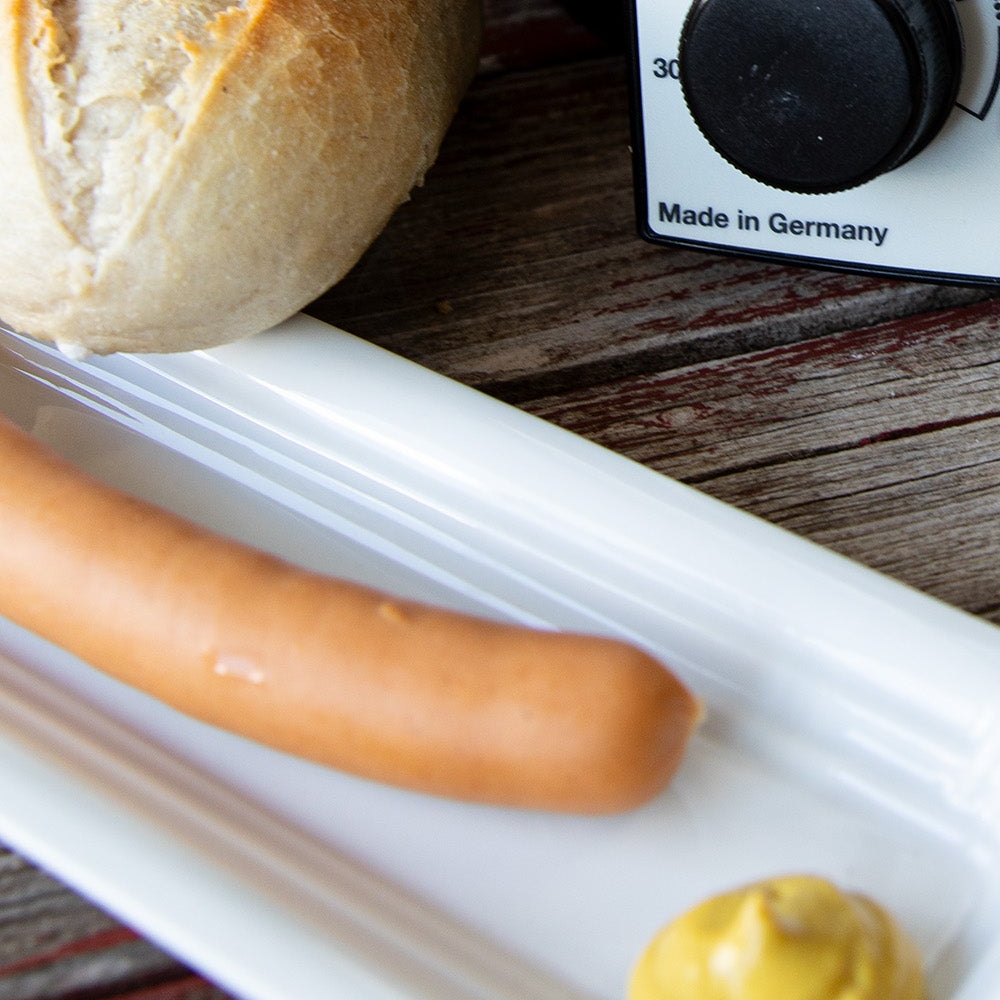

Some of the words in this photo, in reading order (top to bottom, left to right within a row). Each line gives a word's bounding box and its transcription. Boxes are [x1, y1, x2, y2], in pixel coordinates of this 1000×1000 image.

[652, 58, 680, 81] 30
[658, 201, 730, 229] Made
[737, 208, 760, 232] in
[768, 212, 889, 247] Germany
